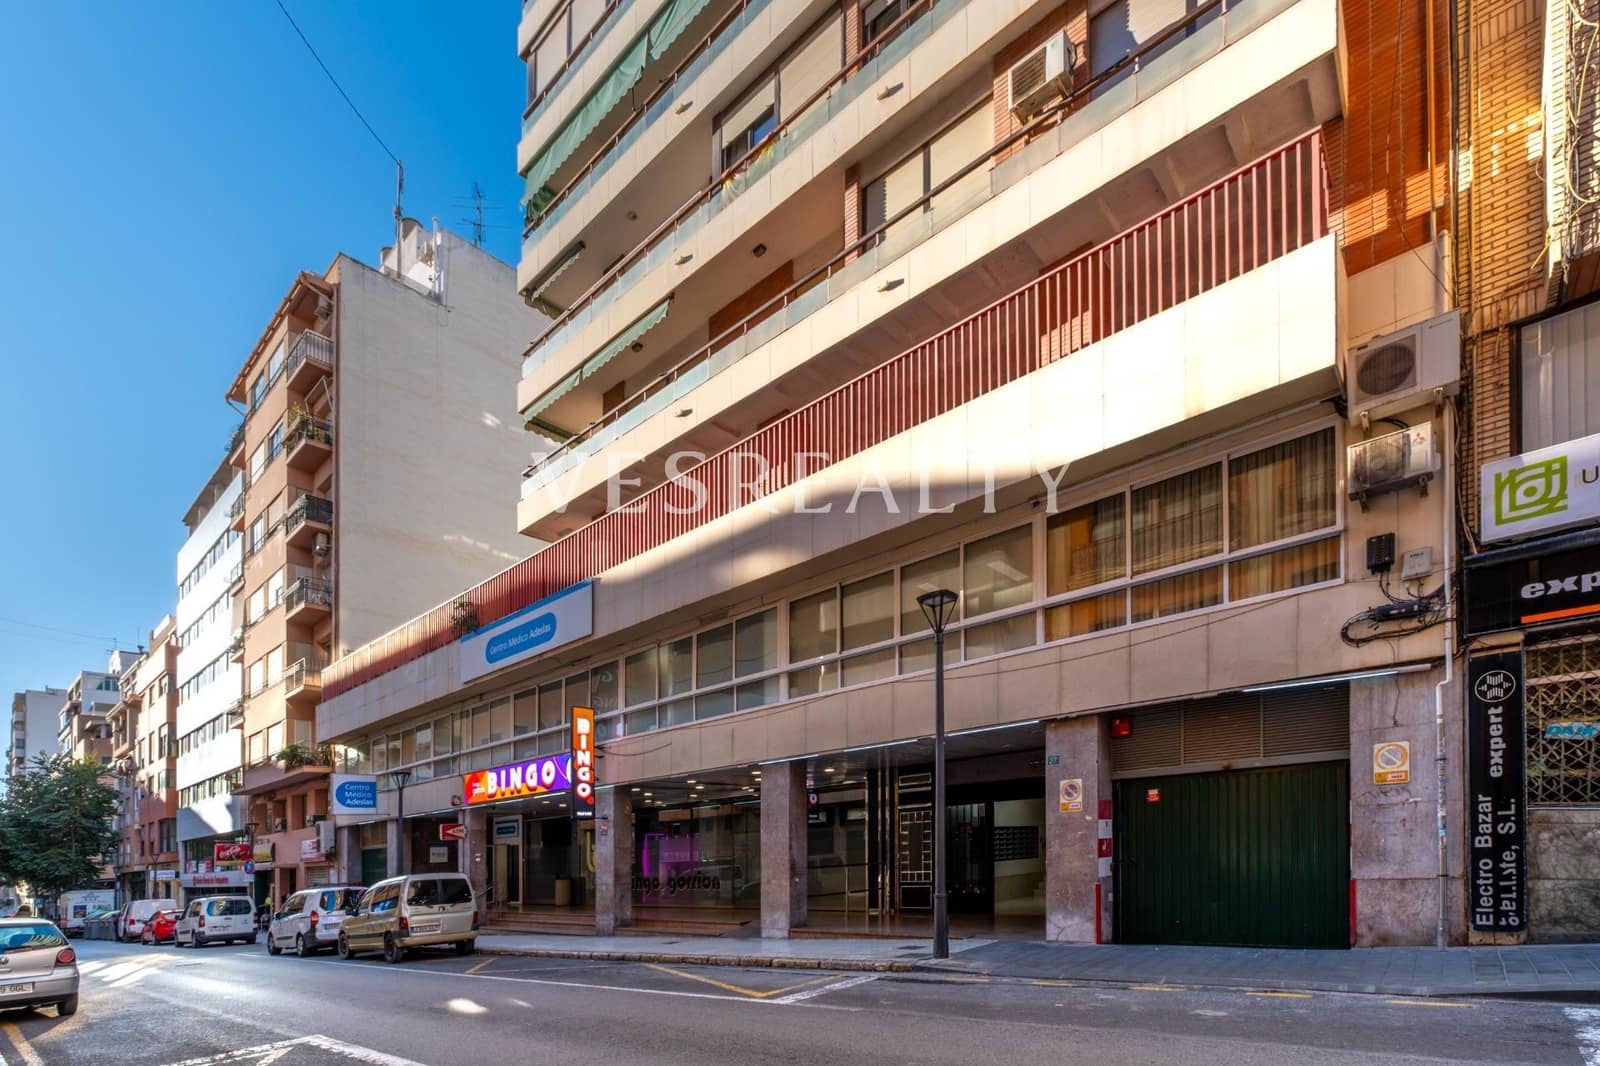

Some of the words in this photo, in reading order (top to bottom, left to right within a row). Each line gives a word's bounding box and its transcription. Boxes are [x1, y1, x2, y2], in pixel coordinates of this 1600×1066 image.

[490, 642, 508, 655] Centro
[529, 624, 552, 640] Adeslas
[576, 718, 591, 798] BINGO
[1487, 706, 1507, 778] expert
[344, 783, 370, 791] Centro
[487, 760, 556, 796] BINGO
[346, 798, 374, 806] Adeslas
[1475, 794, 1493, 848] Bazar
[1476, 857, 1493, 926] Electro
